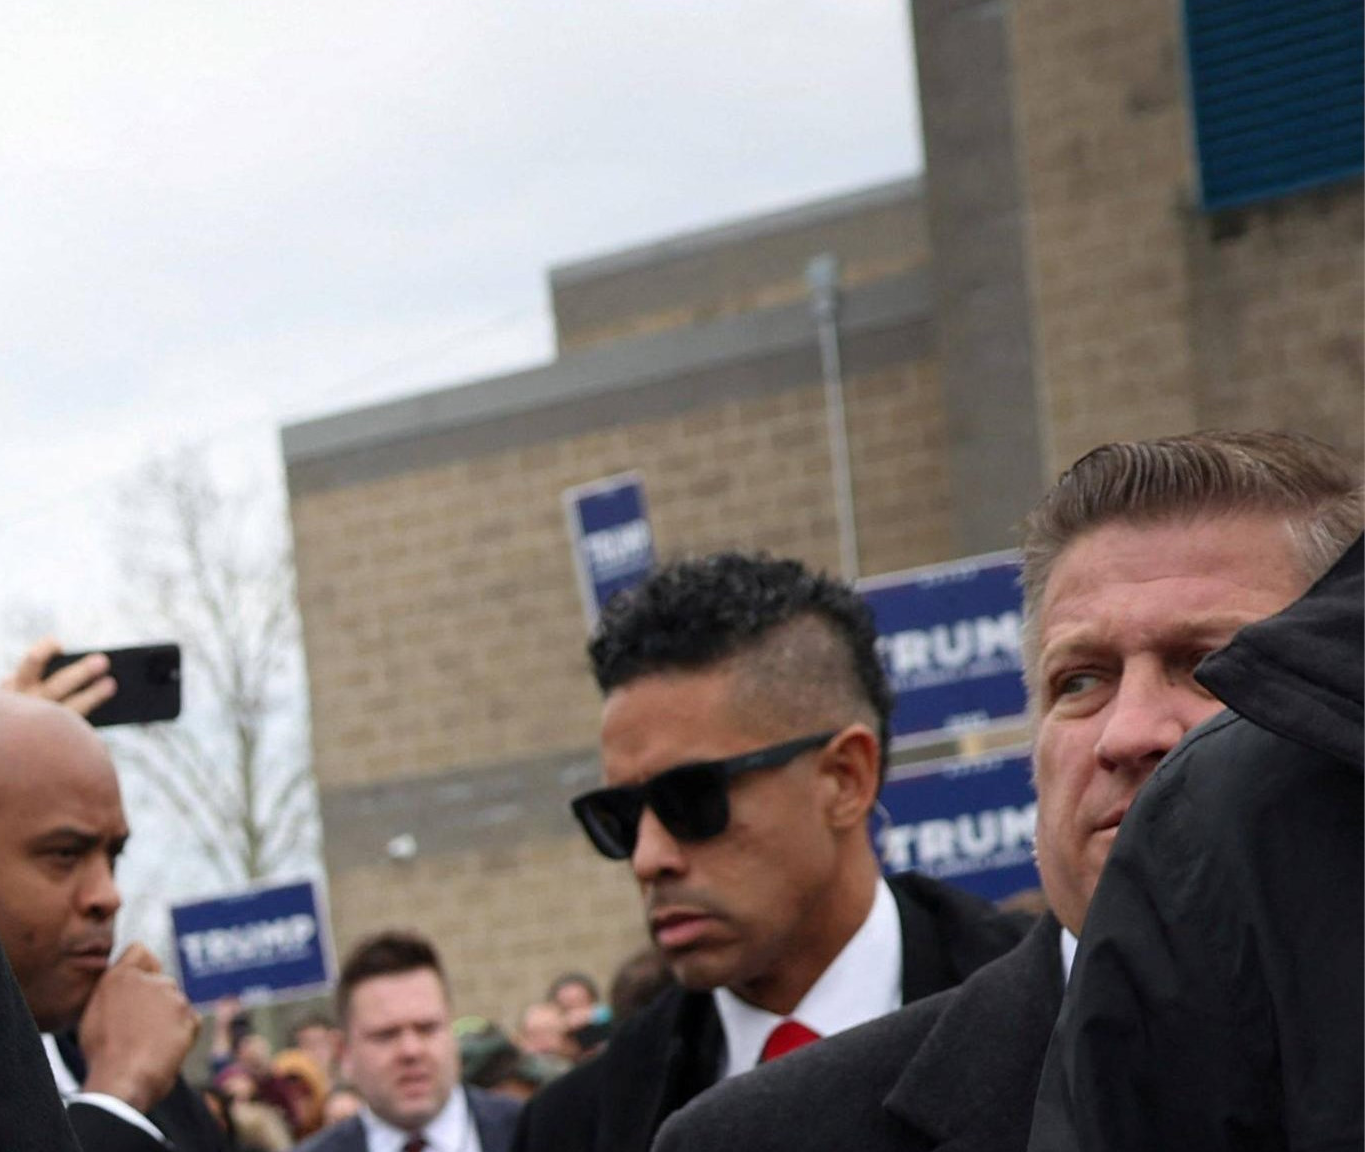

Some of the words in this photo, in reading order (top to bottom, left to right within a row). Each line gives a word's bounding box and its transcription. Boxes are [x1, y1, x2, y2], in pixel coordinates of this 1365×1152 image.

[873, 611, 1021, 676] RUM
[877, 801, 1038, 872] TRUM
[180, 914, 315, 972] TRUMP
